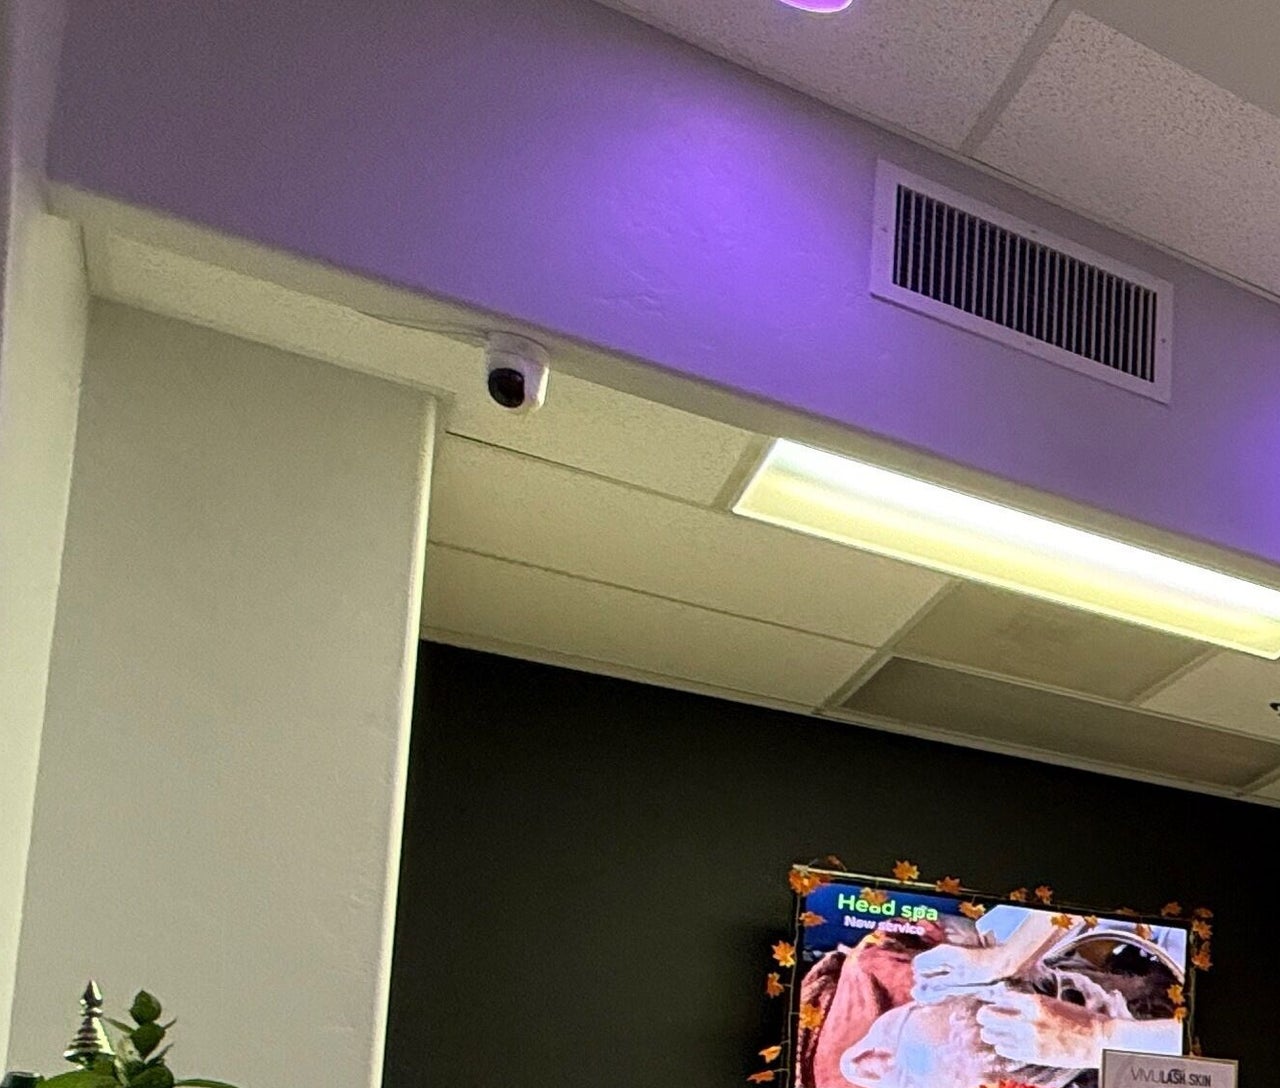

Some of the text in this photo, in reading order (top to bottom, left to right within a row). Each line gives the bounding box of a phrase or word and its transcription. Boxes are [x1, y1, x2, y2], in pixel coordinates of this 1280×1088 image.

[838, 893, 938, 922] Head spa
[844, 915, 925, 936] New service
[1188, 1073, 1212, 1088] SKIN
